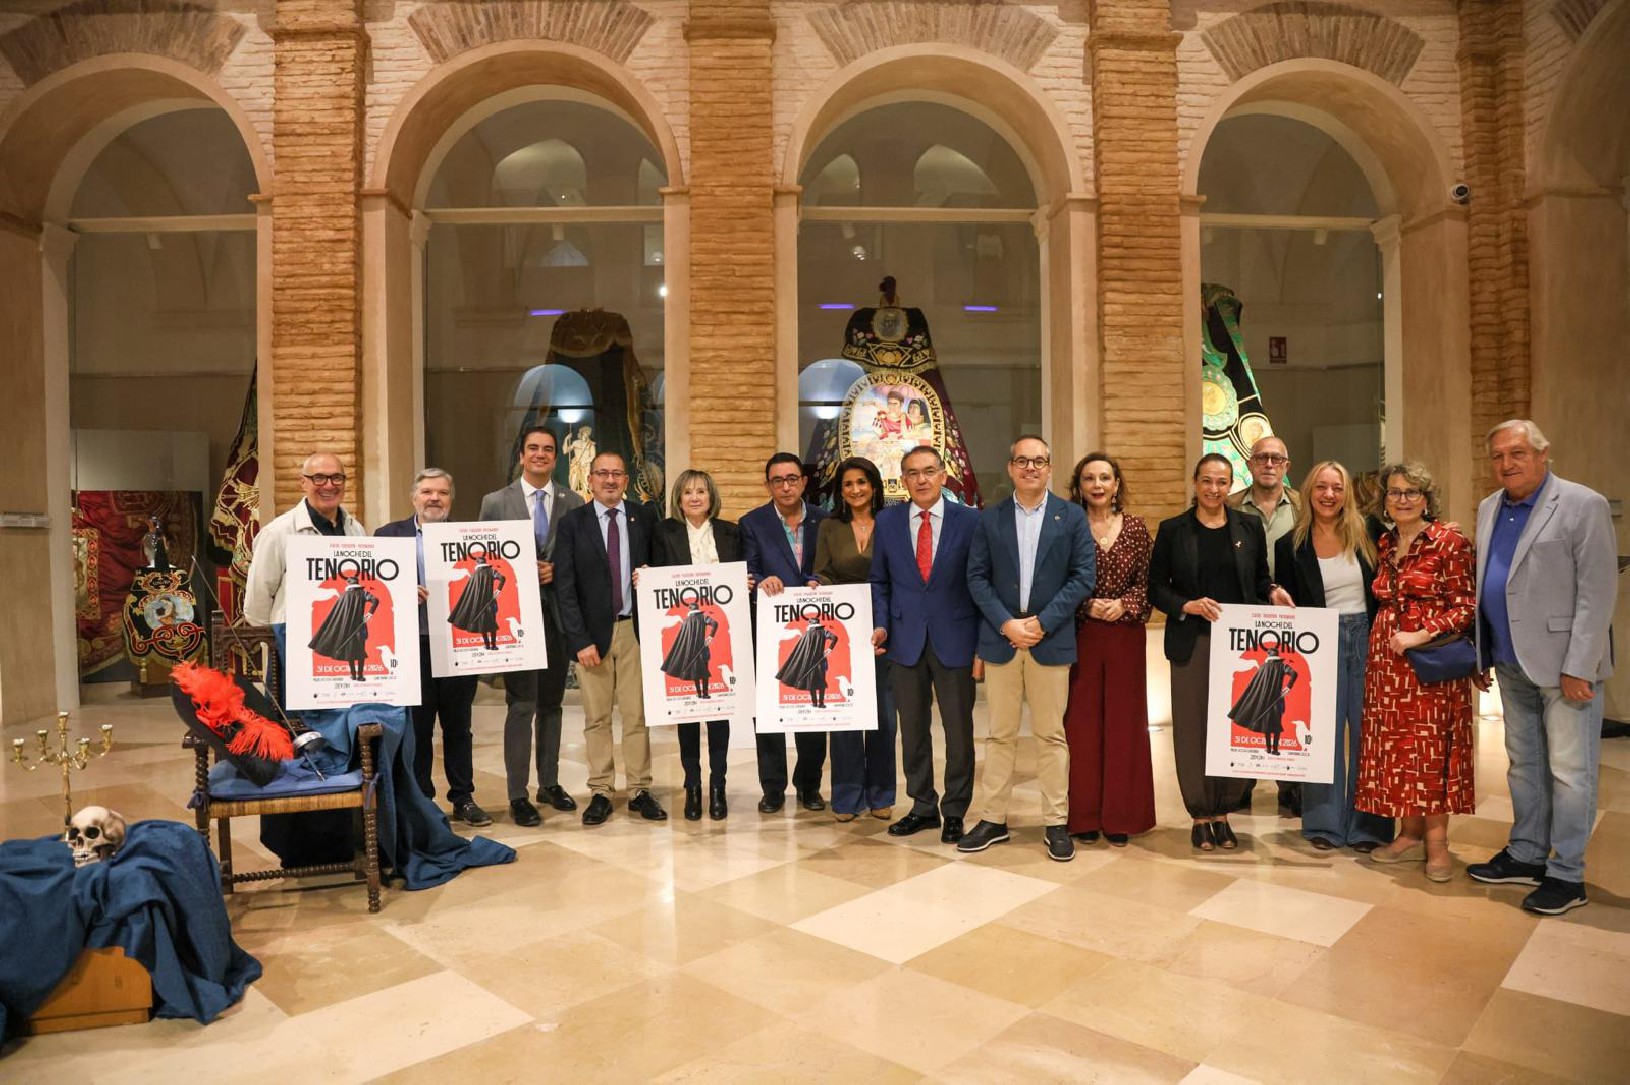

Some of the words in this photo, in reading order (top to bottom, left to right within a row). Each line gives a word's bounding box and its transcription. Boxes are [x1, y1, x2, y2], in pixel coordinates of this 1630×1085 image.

[440, 540, 520, 562] TENORIO
[306, 558, 399, 581] TENORIO
[653, 584, 733, 610] TENORIO
[774, 602, 855, 622] TENORIO
[1255, 620, 1261, 628] LA
[1262, 620, 1282, 629] NOCHE
[1283, 621, 1294, 629] DEL
[1229, 628, 1320, 654] TENORIO
